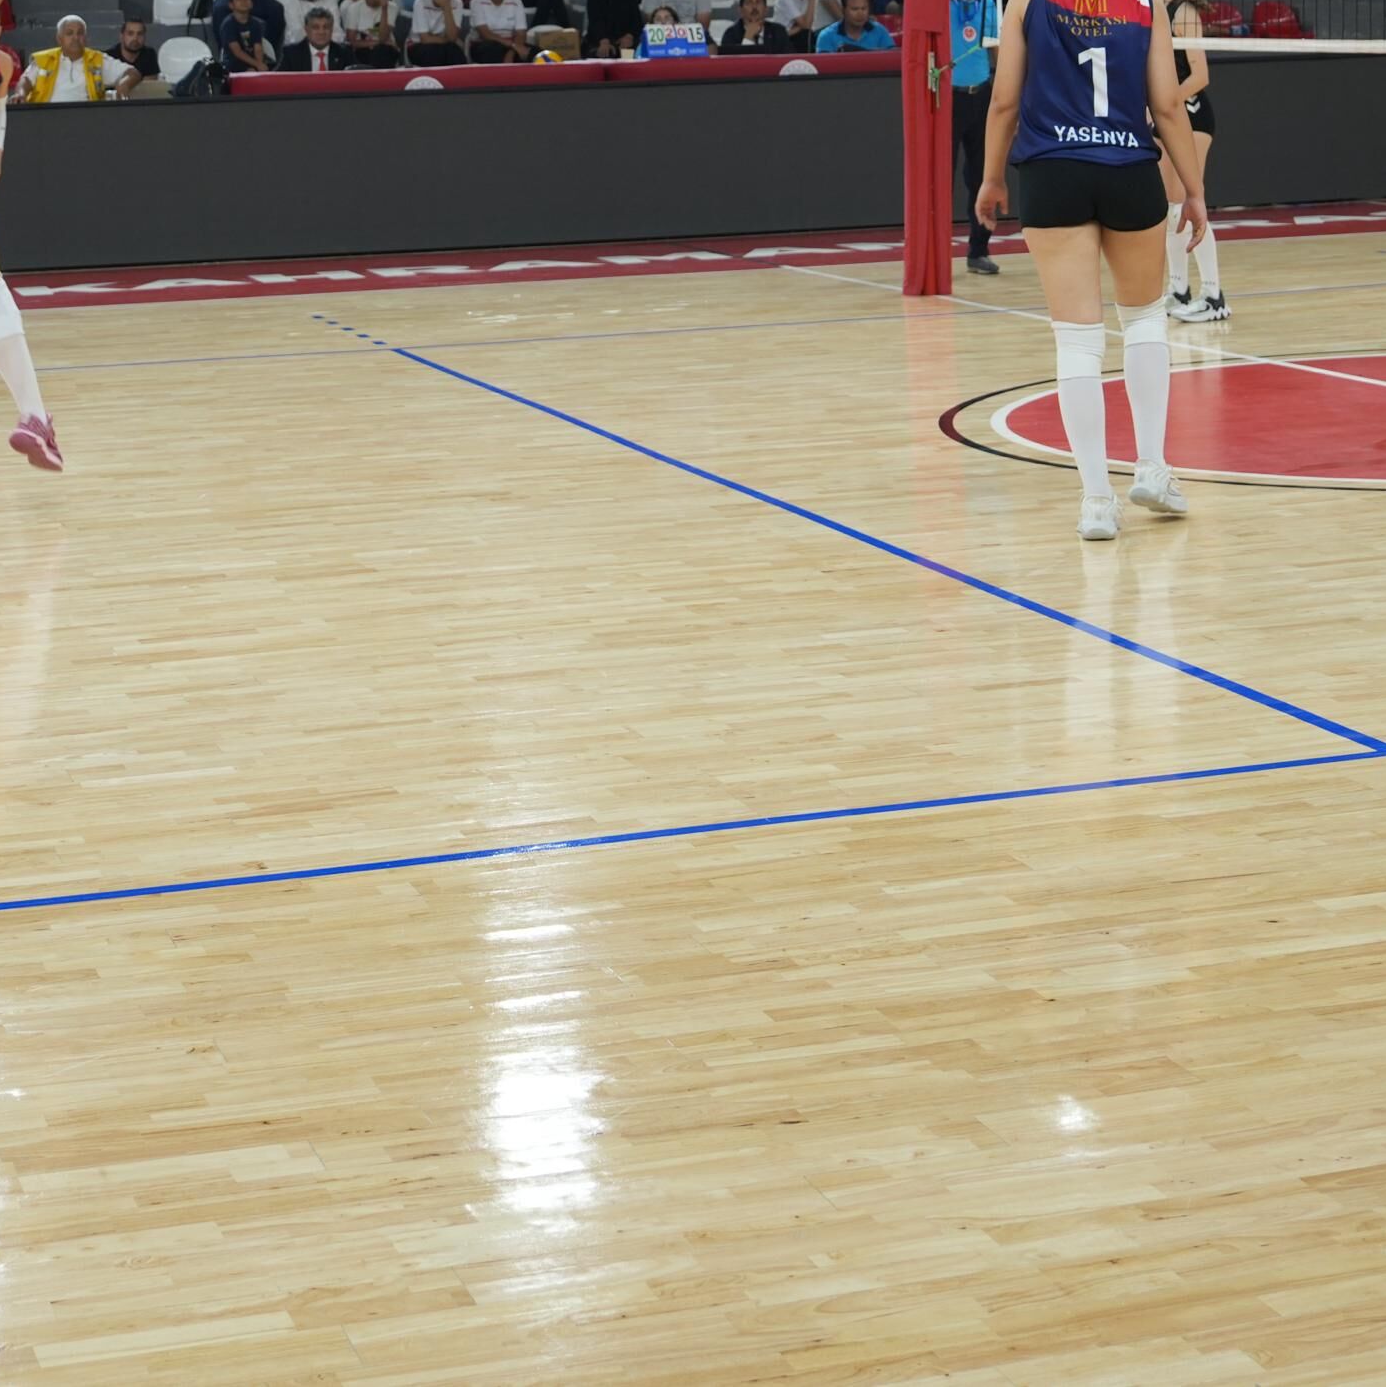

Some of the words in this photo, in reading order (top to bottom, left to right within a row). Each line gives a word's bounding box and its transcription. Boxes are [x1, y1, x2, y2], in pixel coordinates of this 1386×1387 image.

[1070, 25, 1112, 38] OTEL
[1078, 47, 1109, 118] 1
[1054, 126, 1139, 148] YASENYA
